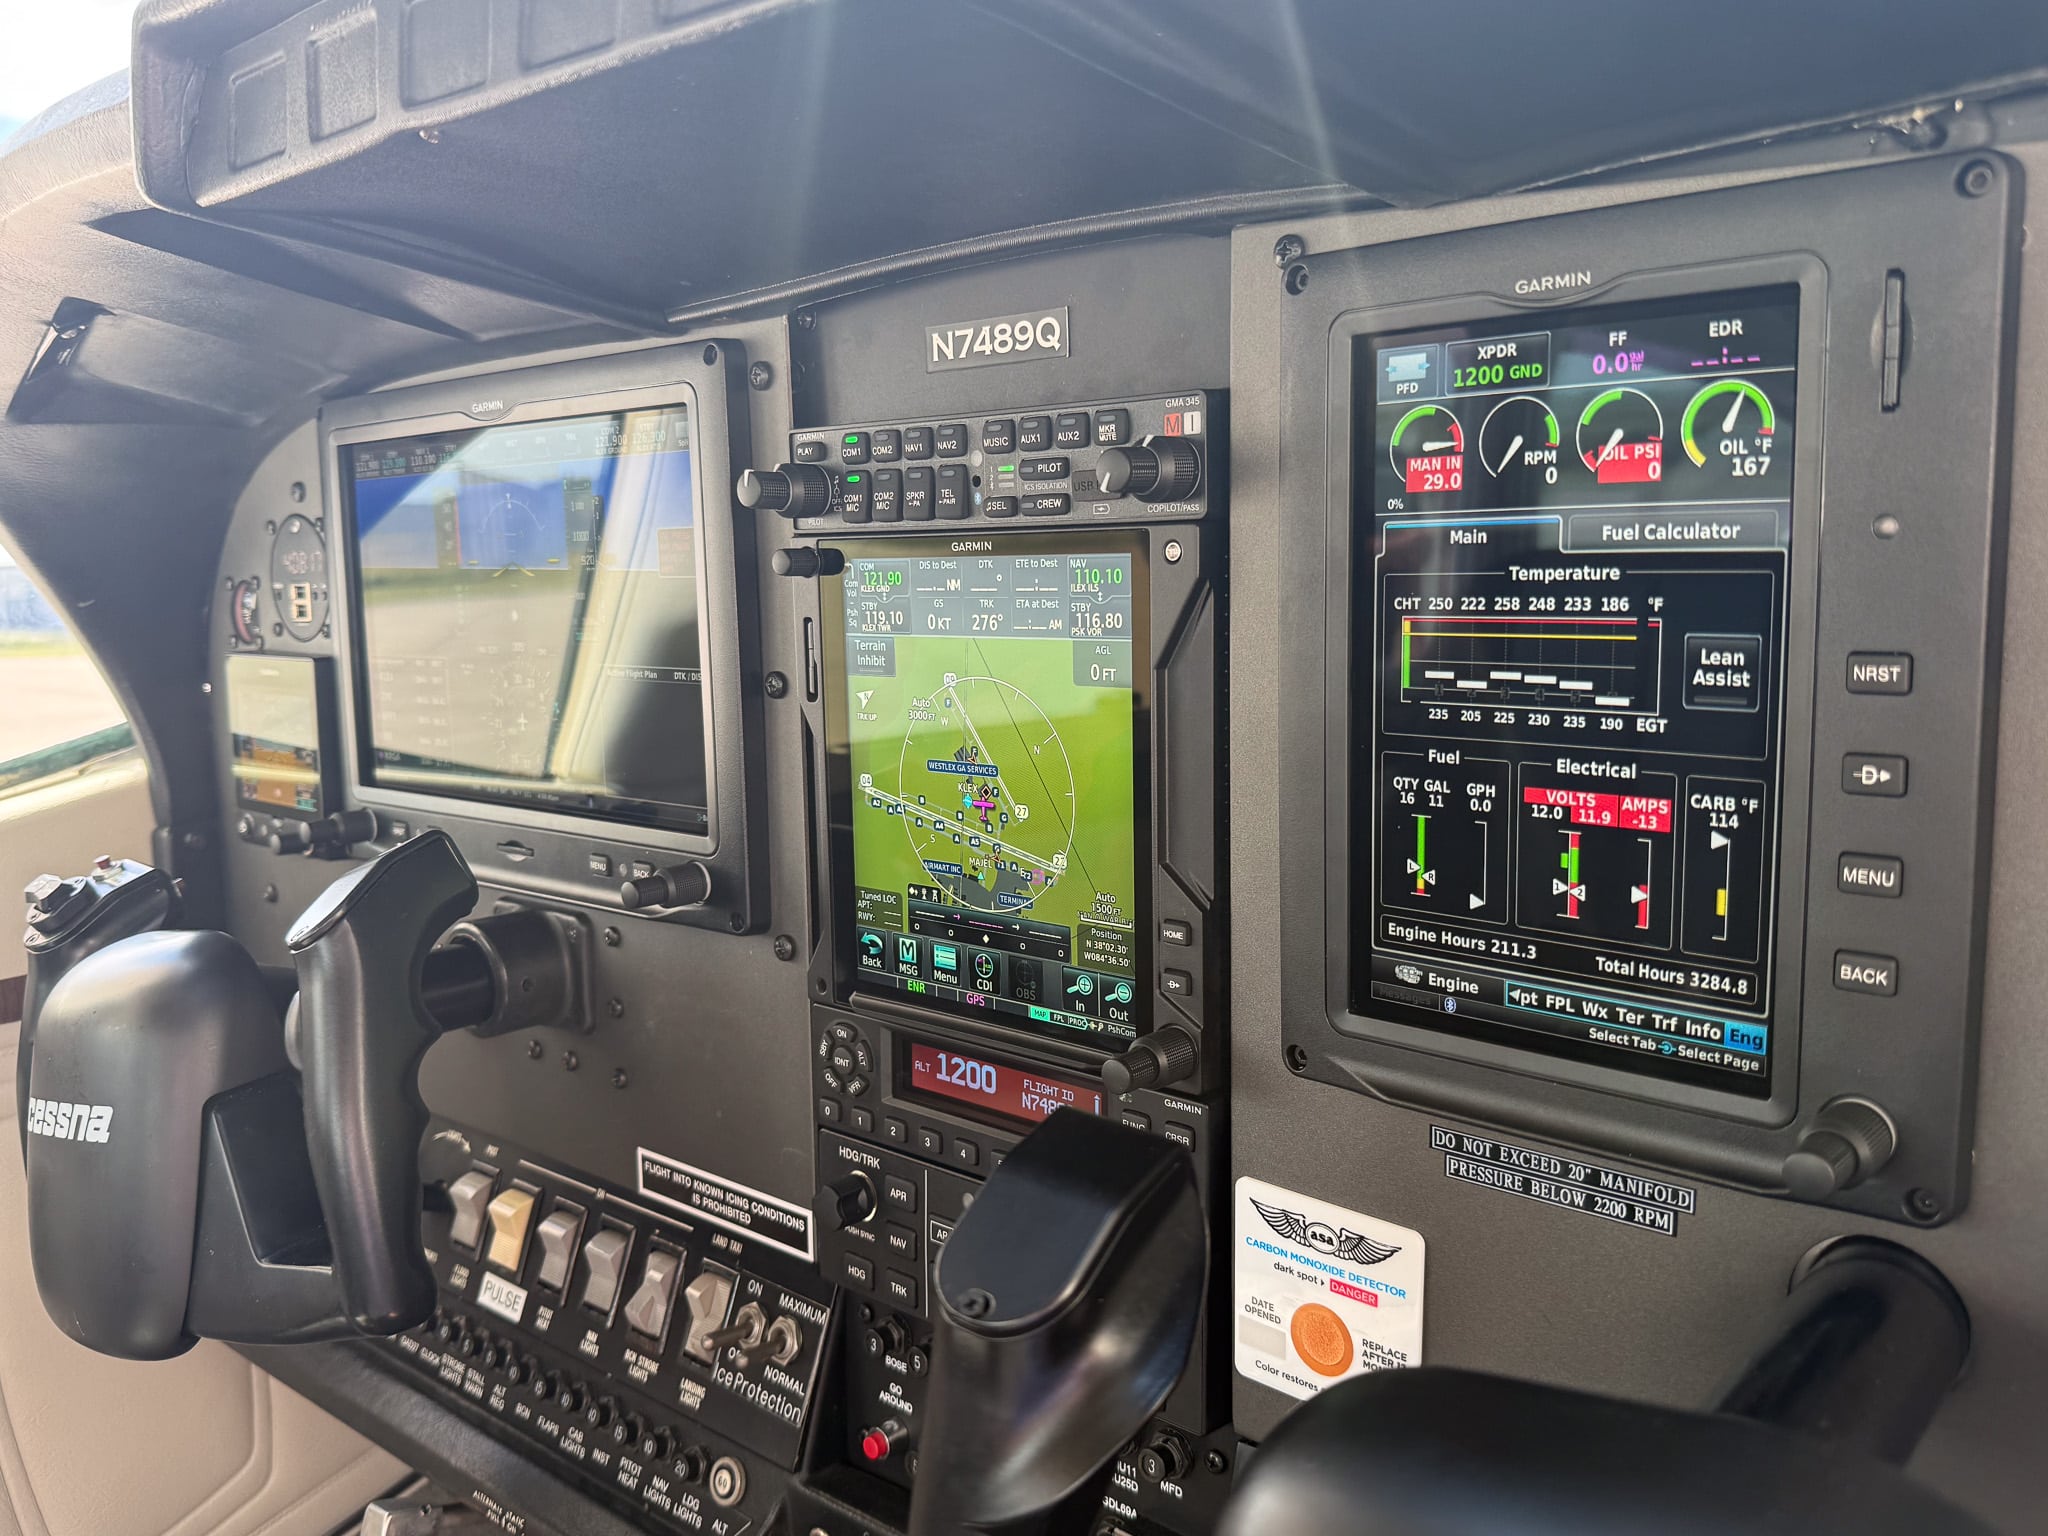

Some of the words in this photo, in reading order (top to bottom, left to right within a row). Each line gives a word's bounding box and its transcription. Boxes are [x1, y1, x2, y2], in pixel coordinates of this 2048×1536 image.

[1515, 271, 1591, 294] GARMIN
[931, 317, 1061, 362] N7489Q
[1608, 331, 1627, 348] FF
[1477, 344, 1517, 360] XPDR
[1452, 365, 1503, 387] 1200
[1510, 363, 1542, 380] GND
[472, 401, 503, 413] GARMIN
[1165, 399, 1183, 408] GMA
[1185, 397, 1200, 406] 345
[984, 437, 1008, 447] MUSIC
[1058, 431, 1079, 441] AUX2
[843, 449, 861, 457] COM1
[873, 446, 893, 455] COM2
[905, 444, 923, 452] NAV1
[937, 441, 957, 450] NAV2
[1604, 445, 1628, 461] OIL
[1634, 442, 1660, 459] PSI
[1720, 439, 1748, 455] OIL
[1410, 458, 1440, 472] MAN
[1445, 457, 1460, 470] IN
[1524, 450, 1556, 465] RPM
[1038, 463, 1062, 472] PILOT
[1731, 457, 1770, 477] 167
[1423, 473, 1461, 490] 29.0
[874, 492, 894, 500] COM2
[1037, 499, 1062, 508] CREW
[1147, 504, 1199, 513] COPILOT/PASS
[1450, 529, 1487, 545] Main
[1602, 524, 1639, 541] Fuel
[1644, 523, 1740, 541] Calculator
[951, 542, 992, 551] GARMIN
[864, 572, 901, 585] 121.90
[1074, 568, 1123, 584] 110.10
[1509, 565, 1620, 584] Temperature
[1394, 597, 1421, 610] CHT
[1428, 597, 1453, 610] 250
[1460, 597, 1486, 611] 222
[1494, 597, 1520, 612] 258
[1528, 597, 1555, 612] 248
[1564, 597, 1592, 612] 233
[1601, 597, 1629, 613] 186
[865, 611, 903, 624] 119.10
[1076, 613, 1123, 628] 116.80
[855, 640, 886, 652] Terrain
[1095, 646, 1111, 654] AGL
[857, 655, 885, 667] Inhibit
[1700, 648, 1744, 666] Lean
[1692, 669, 1751, 688] Assist
[1853, 664, 1901, 683] NRST
[1428, 708, 1448, 720] 235
[1460, 710, 1481, 722] 205
[1494, 712, 1515, 725] 225
[1528, 714, 1550, 727] 230
[1563, 715, 1586, 728] 235
[1600, 717, 1623, 731] 190
[1636, 719, 1667, 733] EGT
[1428, 749, 1460, 765] Fuel
[968, 766, 996, 776] SERVICES
[1556, 759, 1636, 779] Electrical
[958, 783, 978, 793] KLEX
[1393, 776, 1419, 792] QTY
[1424, 779, 1451, 793] GAL
[1466, 784, 1495, 798] GPH
[1400, 791, 1415, 805] 16
[1429, 794, 1444, 807] 11
[1546, 790, 1596, 807] VOLTS
[1622, 798, 1668, 815] AMPS
[1690, 794, 1735, 812] CARB
[1531, 805, 1563, 820] 12.0
[1579, 809, 1611, 825] 11.9
[1709, 813, 1739, 829] 114
[1843, 867, 1894, 888] MENU
[1096, 892, 1116, 903] Auto
[1092, 928, 1122, 940] Position
[1164, 929, 1183, 940] HOME
[1388, 923, 1436, 945] Engine
[1441, 930, 1486, 951] Hours
[1491, 939, 1537, 959] 211.3
[863, 955, 882, 968] Back
[899, 963, 918, 976] MSG
[934, 970, 957, 984] Menu
[1595, 957, 1633, 975] Total
[1638, 965, 1684, 985] Hours
[1689, 972, 1748, 995] 3284.8
[1840, 965, 1888, 986] BACK
[907, 980, 926, 994] ENR
[977, 979, 992, 991] CDI
[1428, 973, 1479, 995] Engine
[967, 994, 984, 1007] GPS
[1109, 1008, 1128, 1021] Out
[1545, 995, 1575, 1013] FPL
[1582, 1001, 1608, 1020] Wx
[1616, 1007, 1644, 1027] Ter
[1652, 1013, 1678, 1033] Trf
[1685, 1019, 1721, 1040] Info
[1730, 1027, 1763, 1050] Eng
[1589, 1028, 1628, 1048] Select
[1633, 1035, 1656, 1051] Tab
[915, 1061, 931, 1072] ALT
[1678, 1045, 1719, 1065] Select
[1724, 1054, 1759, 1072] Page
[937, 1053, 996, 1094] 1200
[1024, 1079, 1059, 1097] FLIGHT
[1062, 1089, 1074, 1101] ID
[1164, 1099, 1202, 1116] GARMIN
[839, 1146, 880, 1169] HDG/TRK
[1436, 1130, 1455, 1149] DO
[1463, 1138, 1492, 1158] NOT
[1500, 1146, 1561, 1175] EXCEED
[1600, 1172, 1690, 1207] MANIFOLD
[645, 1161, 670, 1178] FLIGHT
[673, 1172, 691, 1187] INTO
[694, 1180, 723, 1199] KNOWN
[726, 1192, 749, 1209] ICING
[751, 1202, 805, 1232] CONDITIONS
[890, 1188, 907, 1202] APR
[1450, 1159, 1523, 1192] PRESSURE
[1531, 1180, 1587, 1207] BELOW
[1594, 1197, 1627, 1218] 2200
[1634, 1207, 1669, 1230] RPM
[693, 1193, 700, 1203] IS
[704, 1197, 751, 1225] PROHIBITED
[890, 1236, 907, 1249] NAV
[1310, 1230, 1334, 1246] asa
[848, 1265, 866, 1279] HDG
[1246, 1237, 1288, 1258] CARBON
[1291, 1253, 1345, 1278] MONOXIDE
[1348, 1273, 1406, 1299] DETECTOR
[748, 1280, 763, 1296] ON
[891, 1282, 907, 1296] TRK
[1274, 1262, 1295, 1275] dark
[1297, 1271, 1318, 1286] spot
[1331, 1282, 1376, 1305] DANGER
[484, 1280, 521, 1312] PULSE
[1251, 1296, 1274, 1312] DATE
[779, 1293, 828, 1325] MAXIMUM
[1245, 1304, 1281, 1325] OPENED
[1362, 1339, 1407, 1362] REPLACE
[885, 1355, 907, 1372] BOSE
[764, 1365, 805, 1395] NORMAL
[1255, 1359, 1279, 1376] Color
[1282, 1371, 1318, 1392] restores
[713, 1365, 732, 1386] Ice
[734, 1375, 801, 1422] Protection
[890, 1382, 902, 1396] GO
[879, 1390, 913, 1414] AROUND
[1161, 1481, 1182, 1498] MFD
